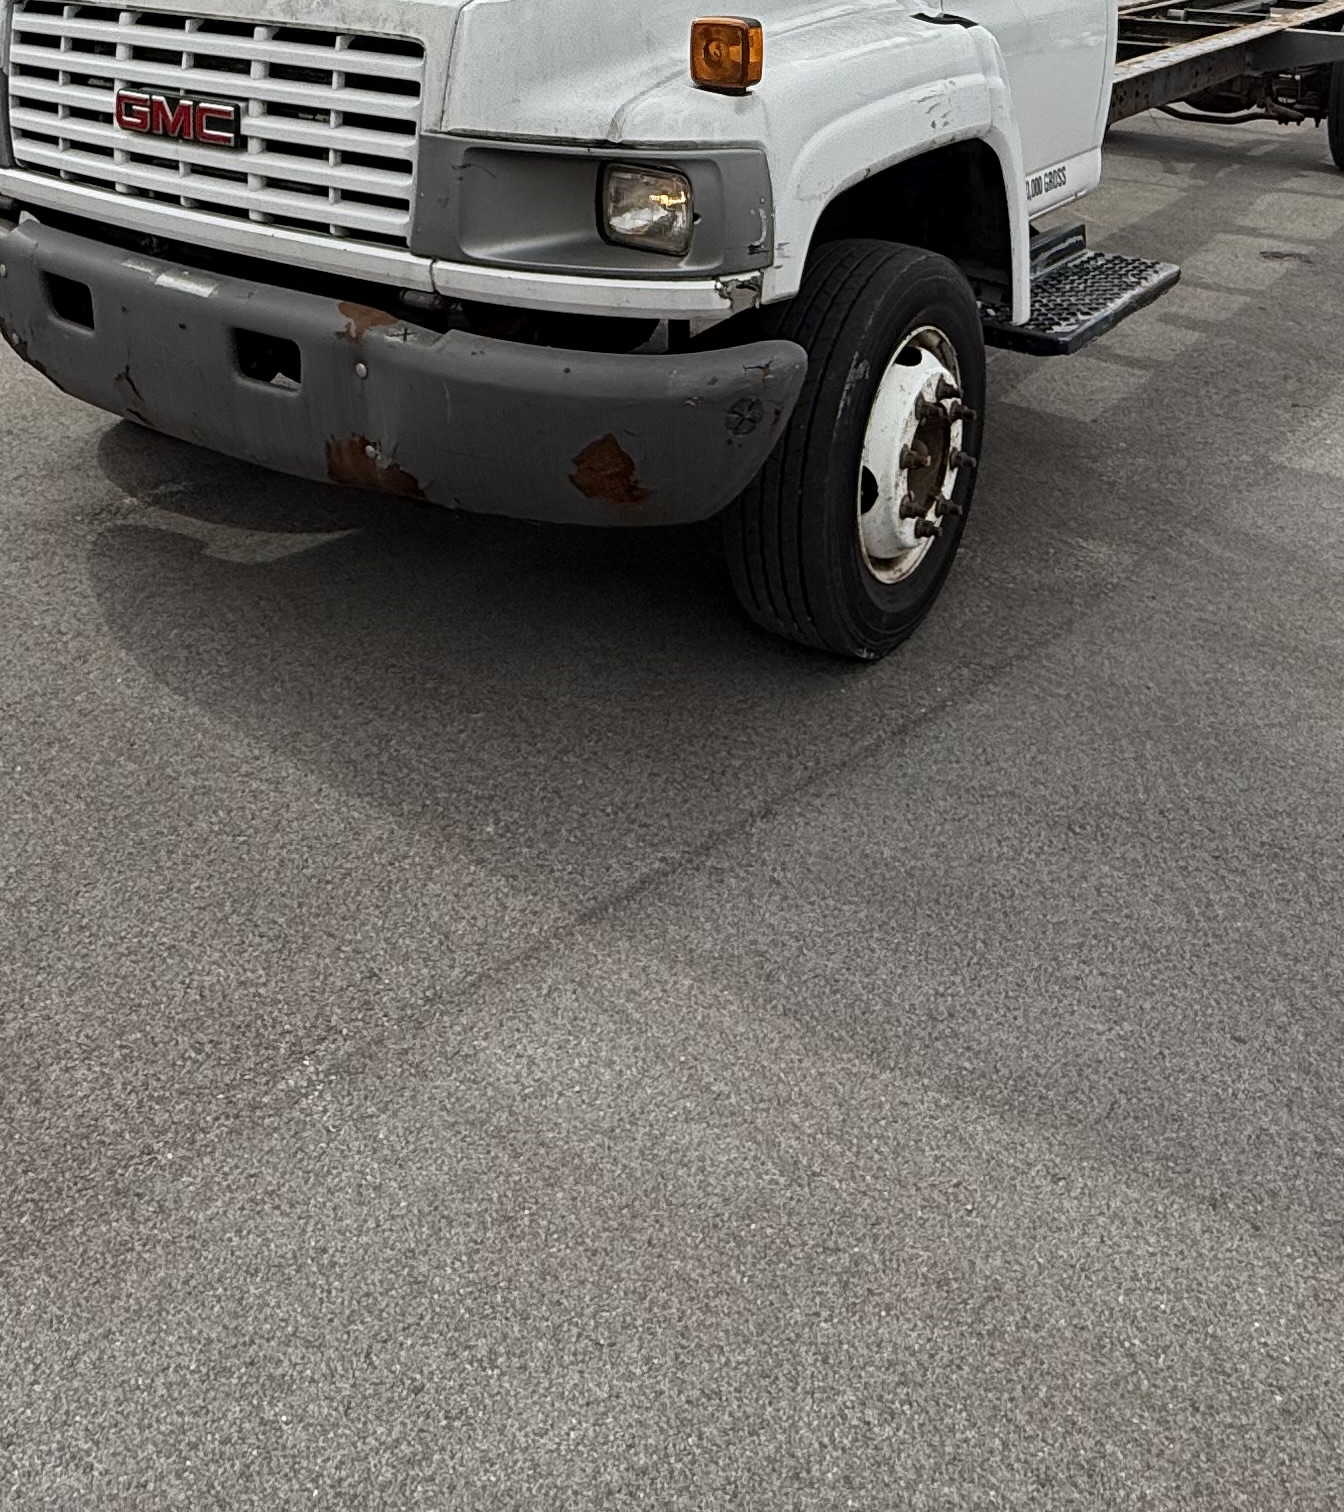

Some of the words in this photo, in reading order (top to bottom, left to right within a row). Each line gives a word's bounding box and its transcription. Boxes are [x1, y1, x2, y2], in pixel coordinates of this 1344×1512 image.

[116, 90, 234, 147] GMC
[1026, 176, 1043, 201] 0,000
[1044, 166, 1066, 193] GROSS
